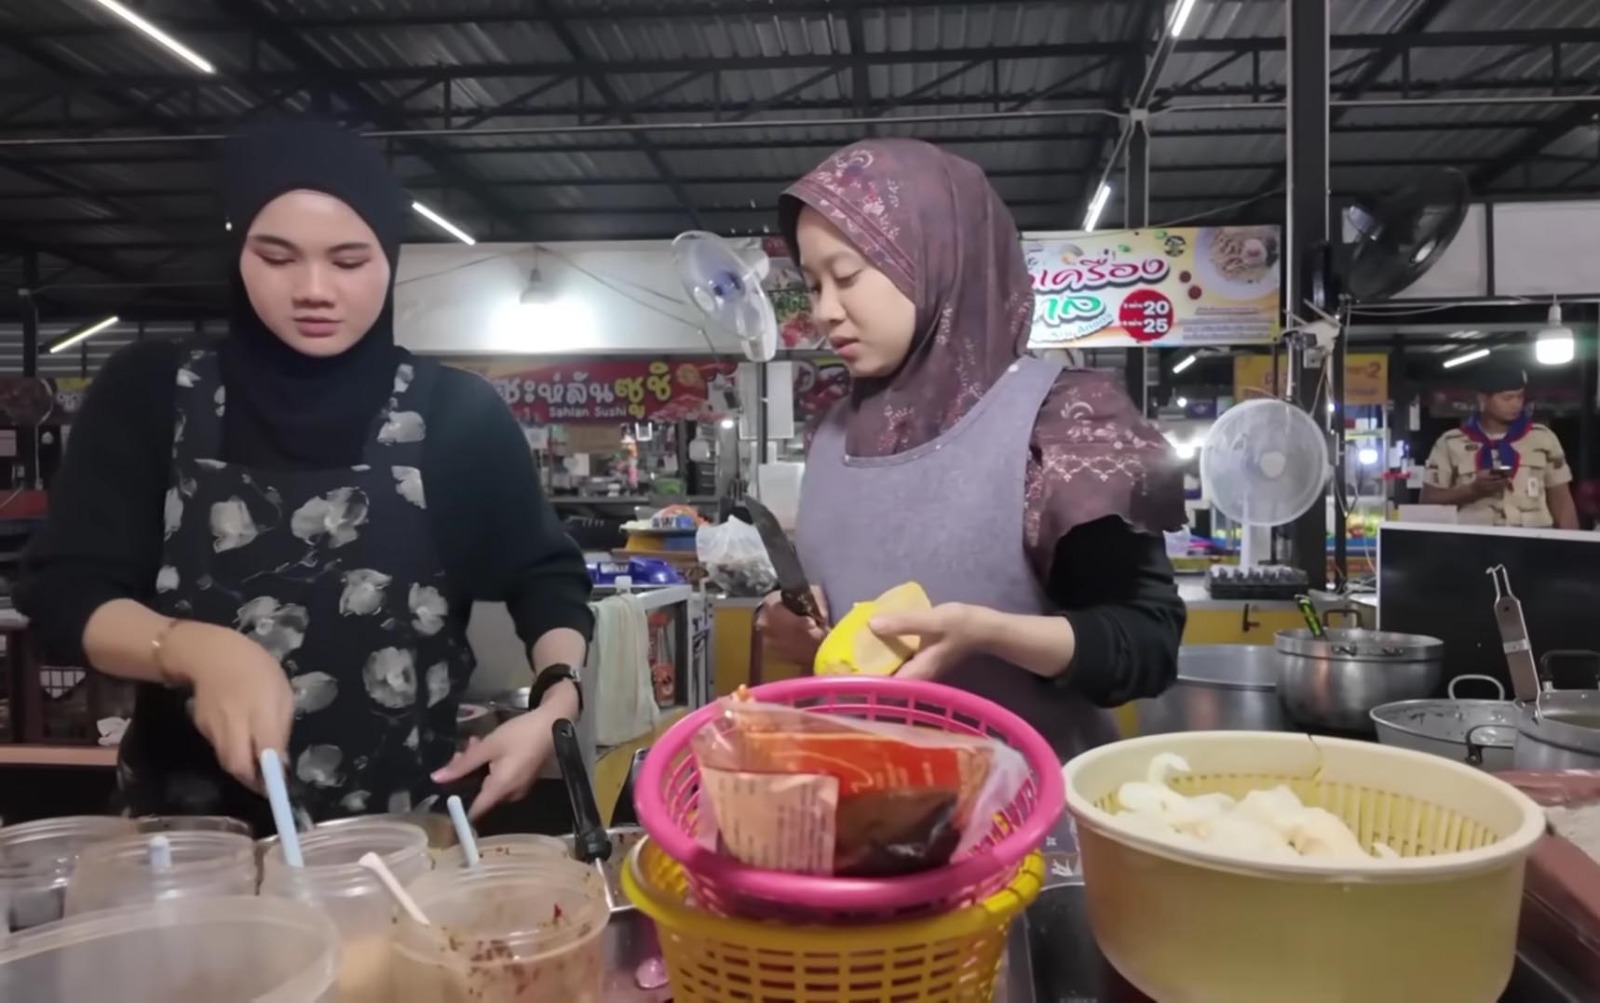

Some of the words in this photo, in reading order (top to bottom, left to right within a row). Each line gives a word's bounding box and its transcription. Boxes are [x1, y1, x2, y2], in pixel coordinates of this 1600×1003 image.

[1143, 300, 1169, 315] 20
[1143, 318, 1169, 333] 25
[549, 406, 590, 418] Sahlan
[594, 406, 627, 418] Sushi
